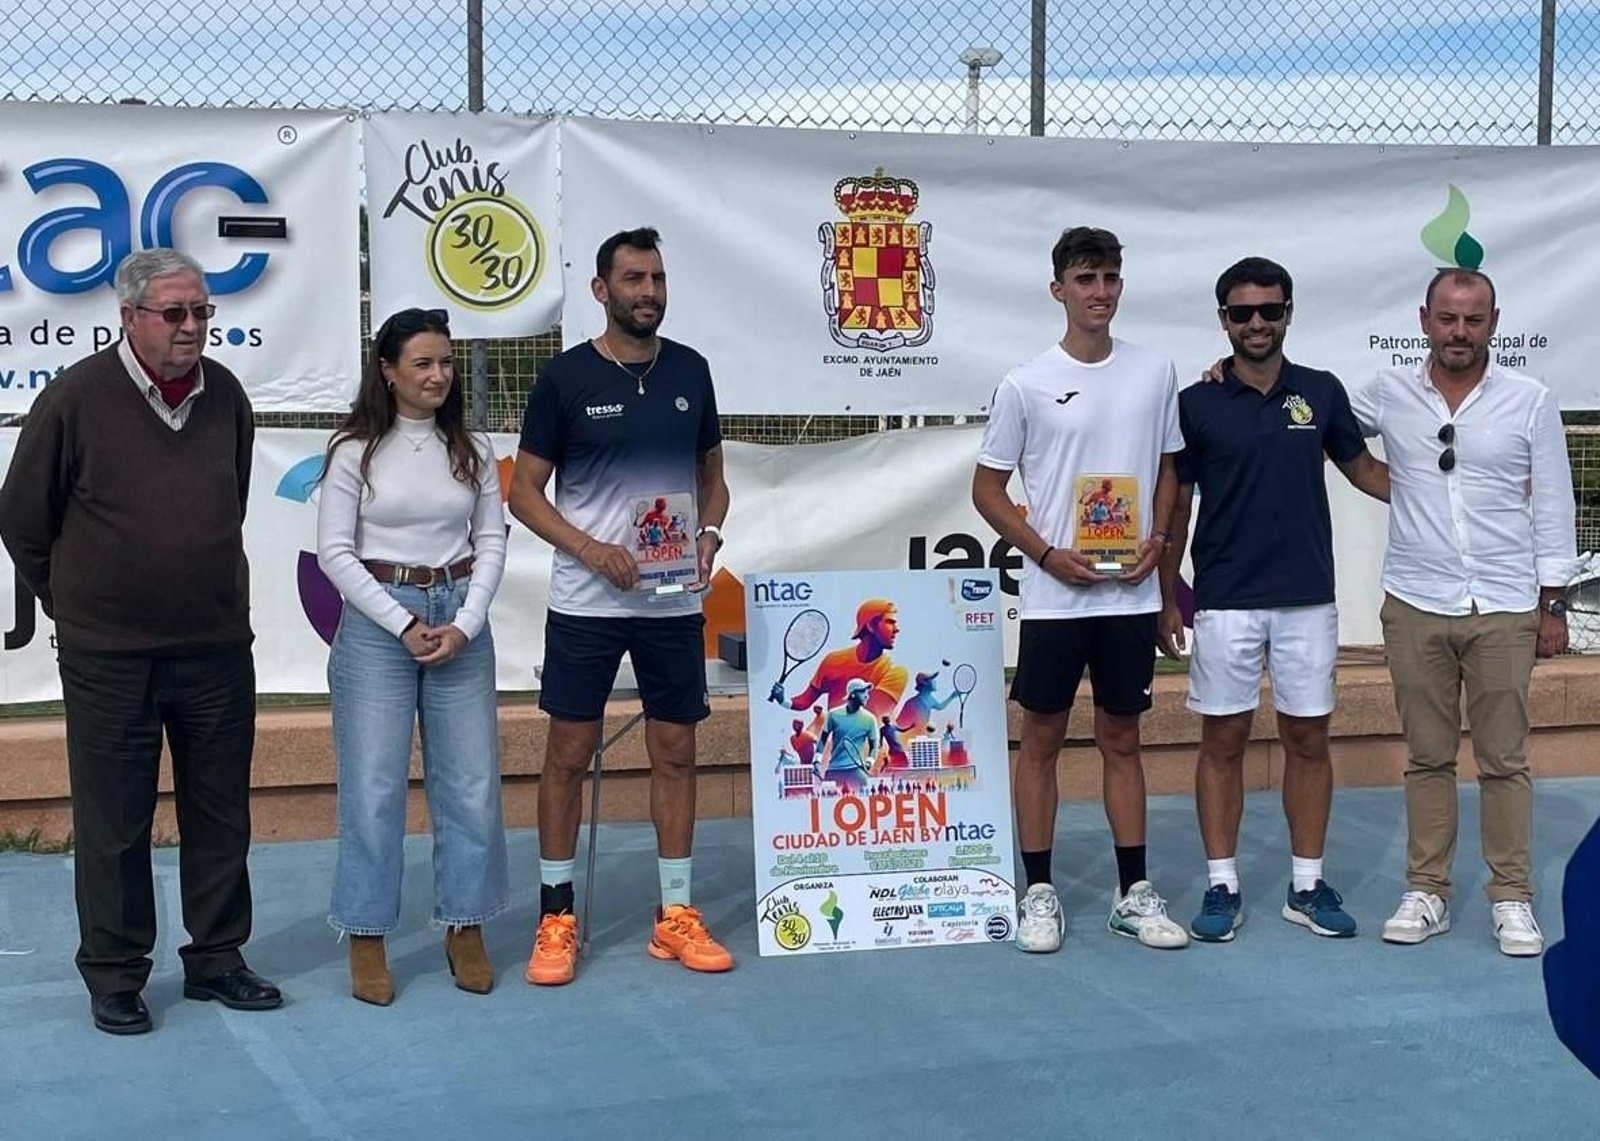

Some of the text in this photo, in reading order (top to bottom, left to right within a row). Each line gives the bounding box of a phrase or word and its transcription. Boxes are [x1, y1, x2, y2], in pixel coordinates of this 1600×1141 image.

[405, 137, 473, 185] Club
[383, 162, 510, 225] Tenis
[30, 319, 75, 345] de
[1529, 333, 1548, 348] de
[863, 355, 938, 366] AYUNTAMIENTO
[860, 366, 902, 378] DE JAÉN
[754, 579, 813, 602] ntac
[965, 611, 995, 625] RFET
[810, 793, 947, 834] I OPEN
[772, 831, 841, 851] CIUDAD
[845, 830, 867, 846] DE
[920, 826, 942, 843] BY
[944, 821, 997, 842] ntac
[793, 881, 834, 891] ORGANIZA
[913, 874, 959, 884] COLABORAN
[869, 888, 897, 899] NDL
[760, 901, 800, 924] Tenis
